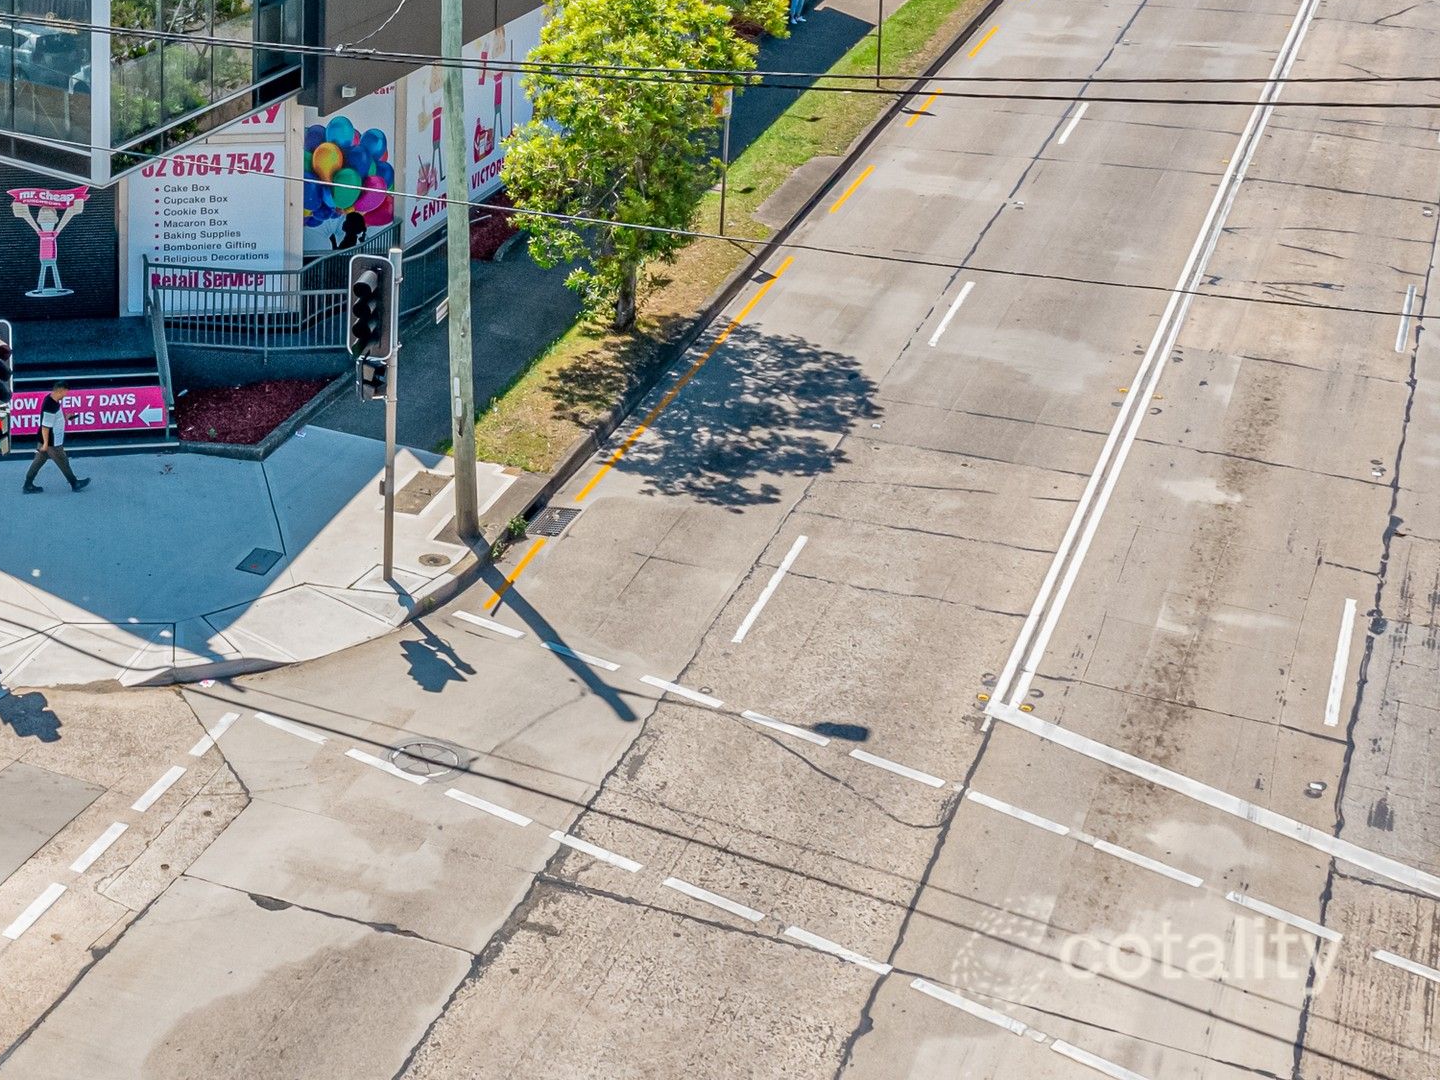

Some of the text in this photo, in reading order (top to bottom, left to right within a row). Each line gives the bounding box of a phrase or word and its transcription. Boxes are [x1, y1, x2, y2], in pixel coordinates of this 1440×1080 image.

[172, 154, 221, 176] 8764
[226, 151, 275, 175] 7542
[163, 184, 210, 193] Cake Box
[20, 190, 75, 206] mr. cheap
[163, 195, 228, 206] Cupcake Box
[163, 207, 219, 216] Cookie Box
[423, 192, 447, 222] ENTR
[163, 218, 228, 228] Macaron Box
[163, 230, 241, 241] Baking Supplies
[163, 241, 257, 252] Bomboniere Gifting
[163, 252, 270, 265] Religious Decorations
[151, 270, 264, 289] Retail Service
[86, 395, 95, 407] 7
[100, 393, 136, 406] DAYS
[11, 414, 41, 429] NTR
[99, 410, 137, 424] WAY
